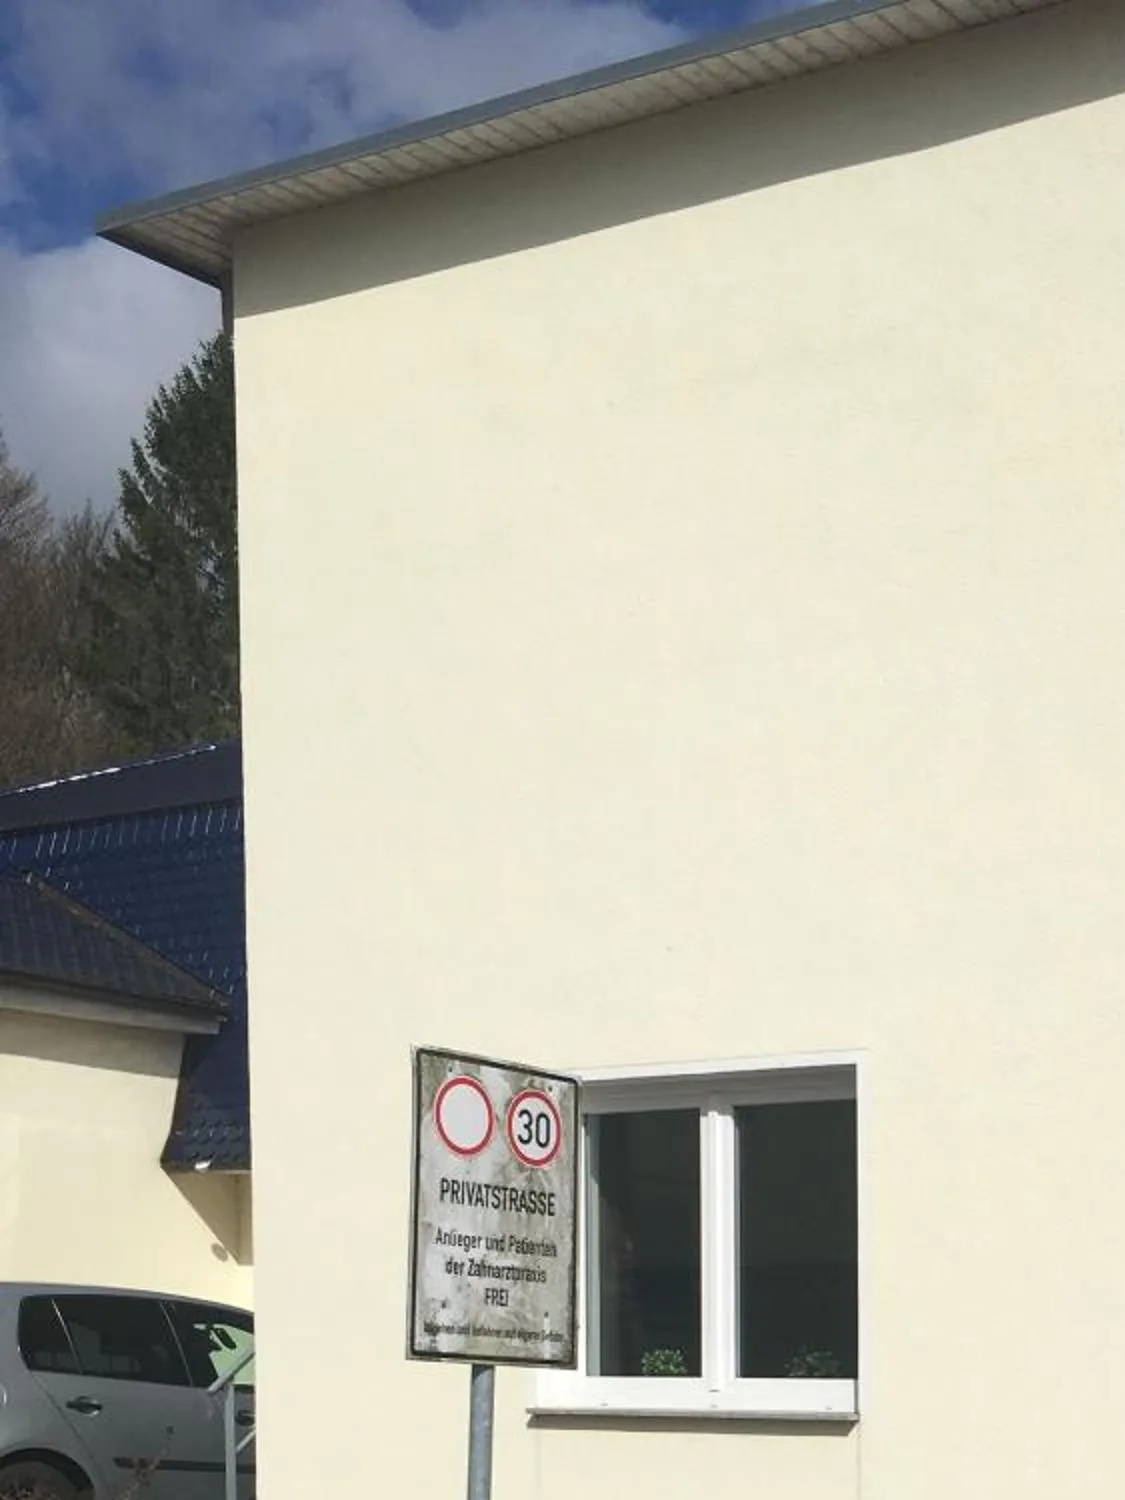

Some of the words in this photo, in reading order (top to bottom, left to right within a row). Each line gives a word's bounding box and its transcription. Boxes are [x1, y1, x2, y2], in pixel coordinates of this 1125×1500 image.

[517, 1109, 550, 1148] 30
[440, 1177, 556, 1216] PRIVATSTRASSE
[435, 1227, 482, 1252] Anlieger
[485, 1233, 505, 1253] und
[508, 1235, 557, 1258] Patienten
[445, 1256, 465, 1275] der
[468, 1258, 547, 1286] Zahnarztpraxis
[484, 1288, 509, 1307] FREI
